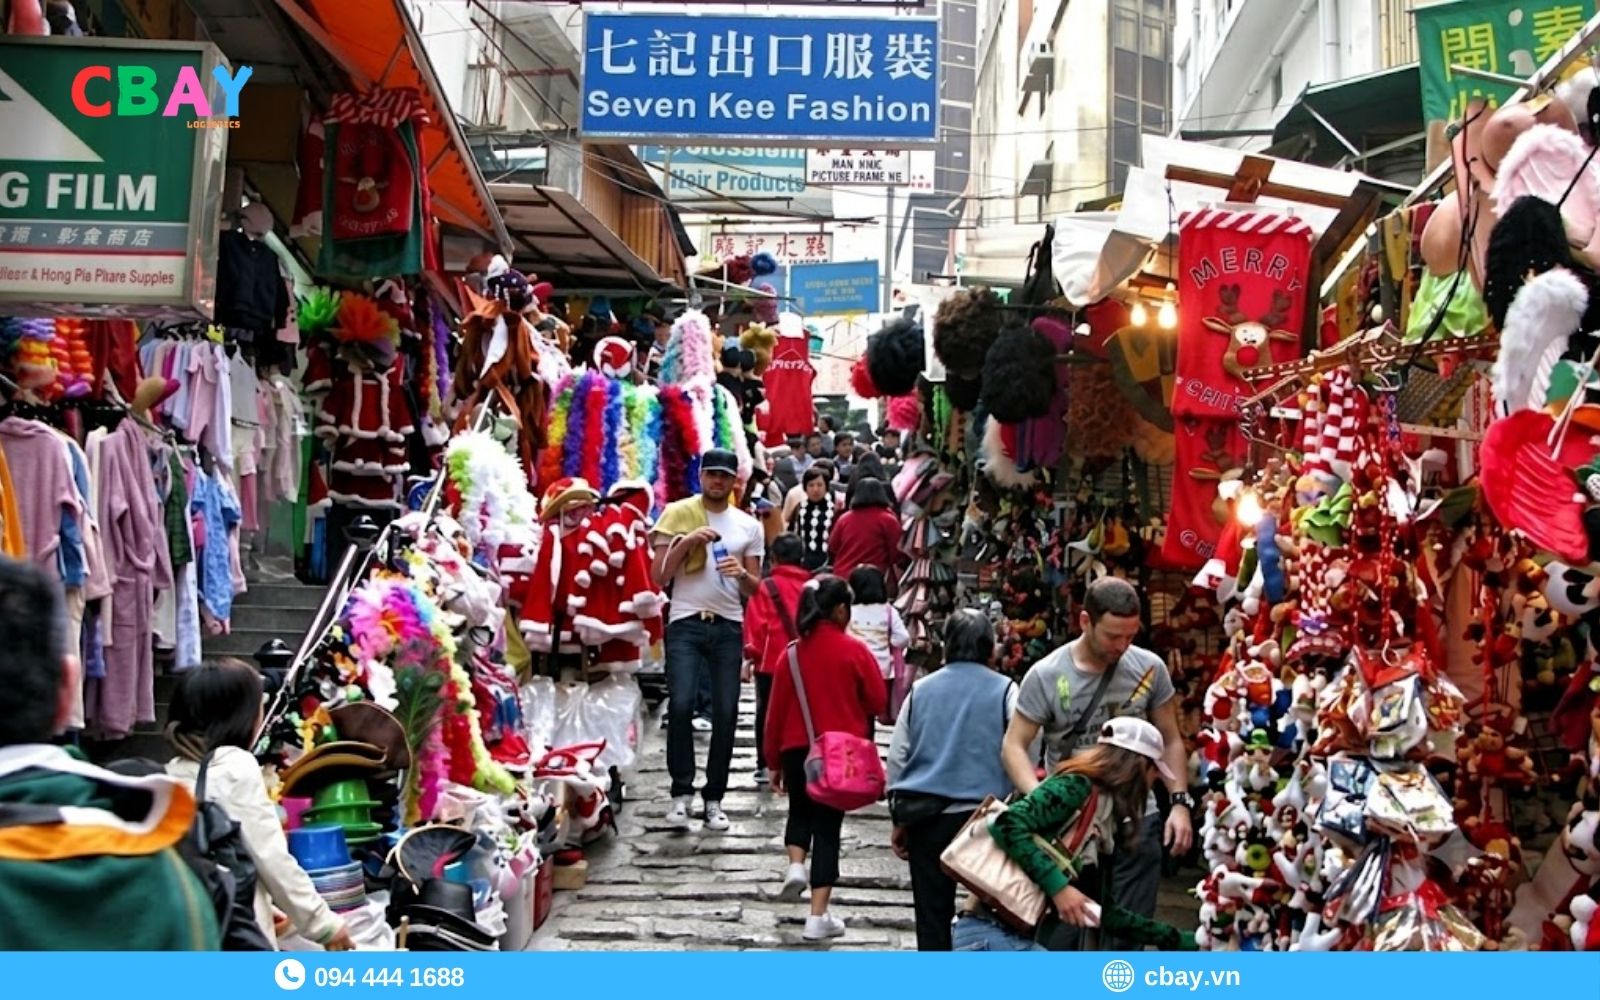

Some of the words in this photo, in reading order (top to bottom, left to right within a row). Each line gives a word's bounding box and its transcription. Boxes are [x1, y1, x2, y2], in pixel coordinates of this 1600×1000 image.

[588, 29, 934, 80] 七記出口服裝
[587, 90, 696, 118] Seven
[709, 93, 775, 119] Kee
[788, 94, 931, 122] Fashion
[717, 171, 805, 192] Products
[854, 171, 884, 182] FRAME
[46, 173, 157, 212] FILM
[41, 268, 71, 285] Hong
